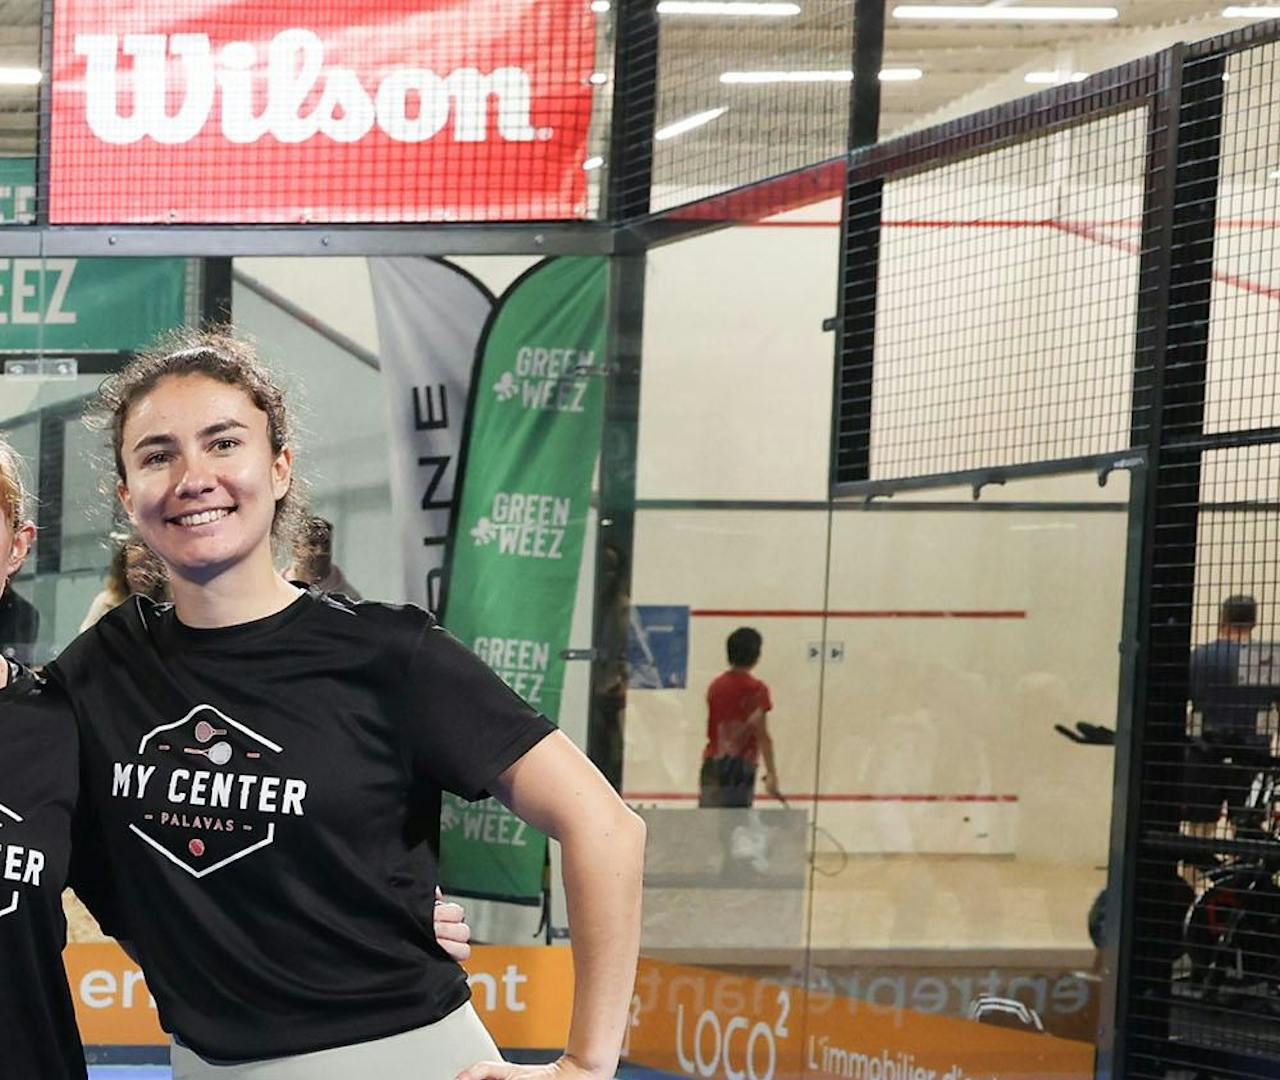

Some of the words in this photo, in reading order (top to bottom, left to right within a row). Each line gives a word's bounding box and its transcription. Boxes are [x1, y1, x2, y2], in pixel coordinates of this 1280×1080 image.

[516, 346, 595, 379] GREEN
[521, 378, 588, 413] WEEZ
[492, 493, 571, 527] GREEN
[498, 524, 565, 560] WEEZ
[112, 762, 155, 799] MY
[167, 768, 307, 816] CENTER
[161, 812, 235, 832] PALAVAS
[463, 813, 527, 846] WEEZ
